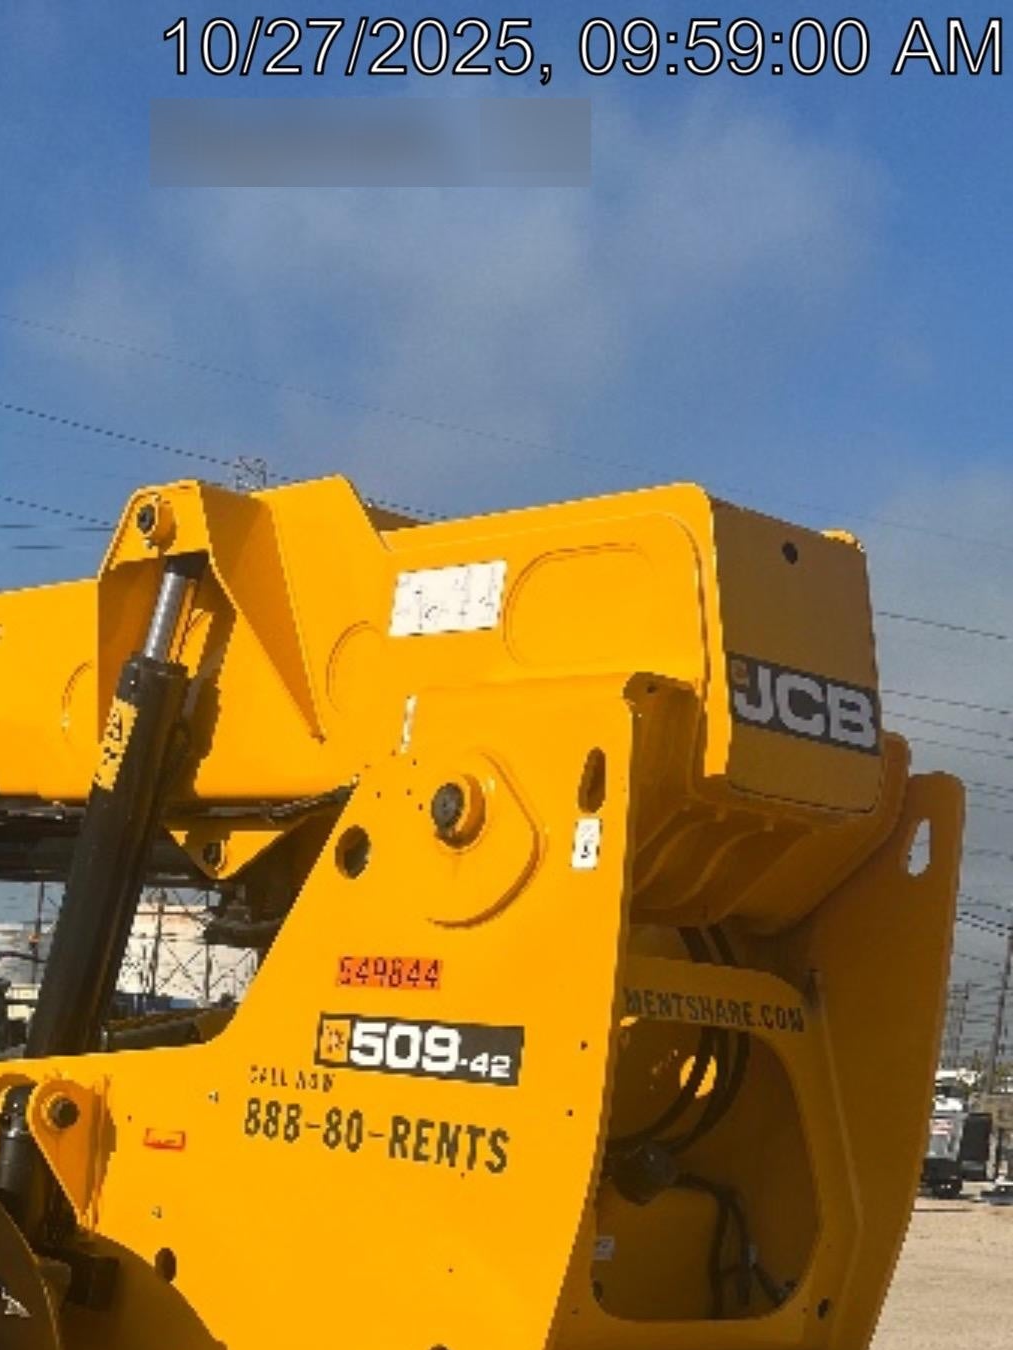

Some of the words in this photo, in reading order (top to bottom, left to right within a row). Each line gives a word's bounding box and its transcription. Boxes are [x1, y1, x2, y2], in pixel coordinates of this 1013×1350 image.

[733, 664, 877, 749] JCB
[339, 957, 440, 988] 549844
[244, 1097, 510, 1174] 888-80-RENTS
